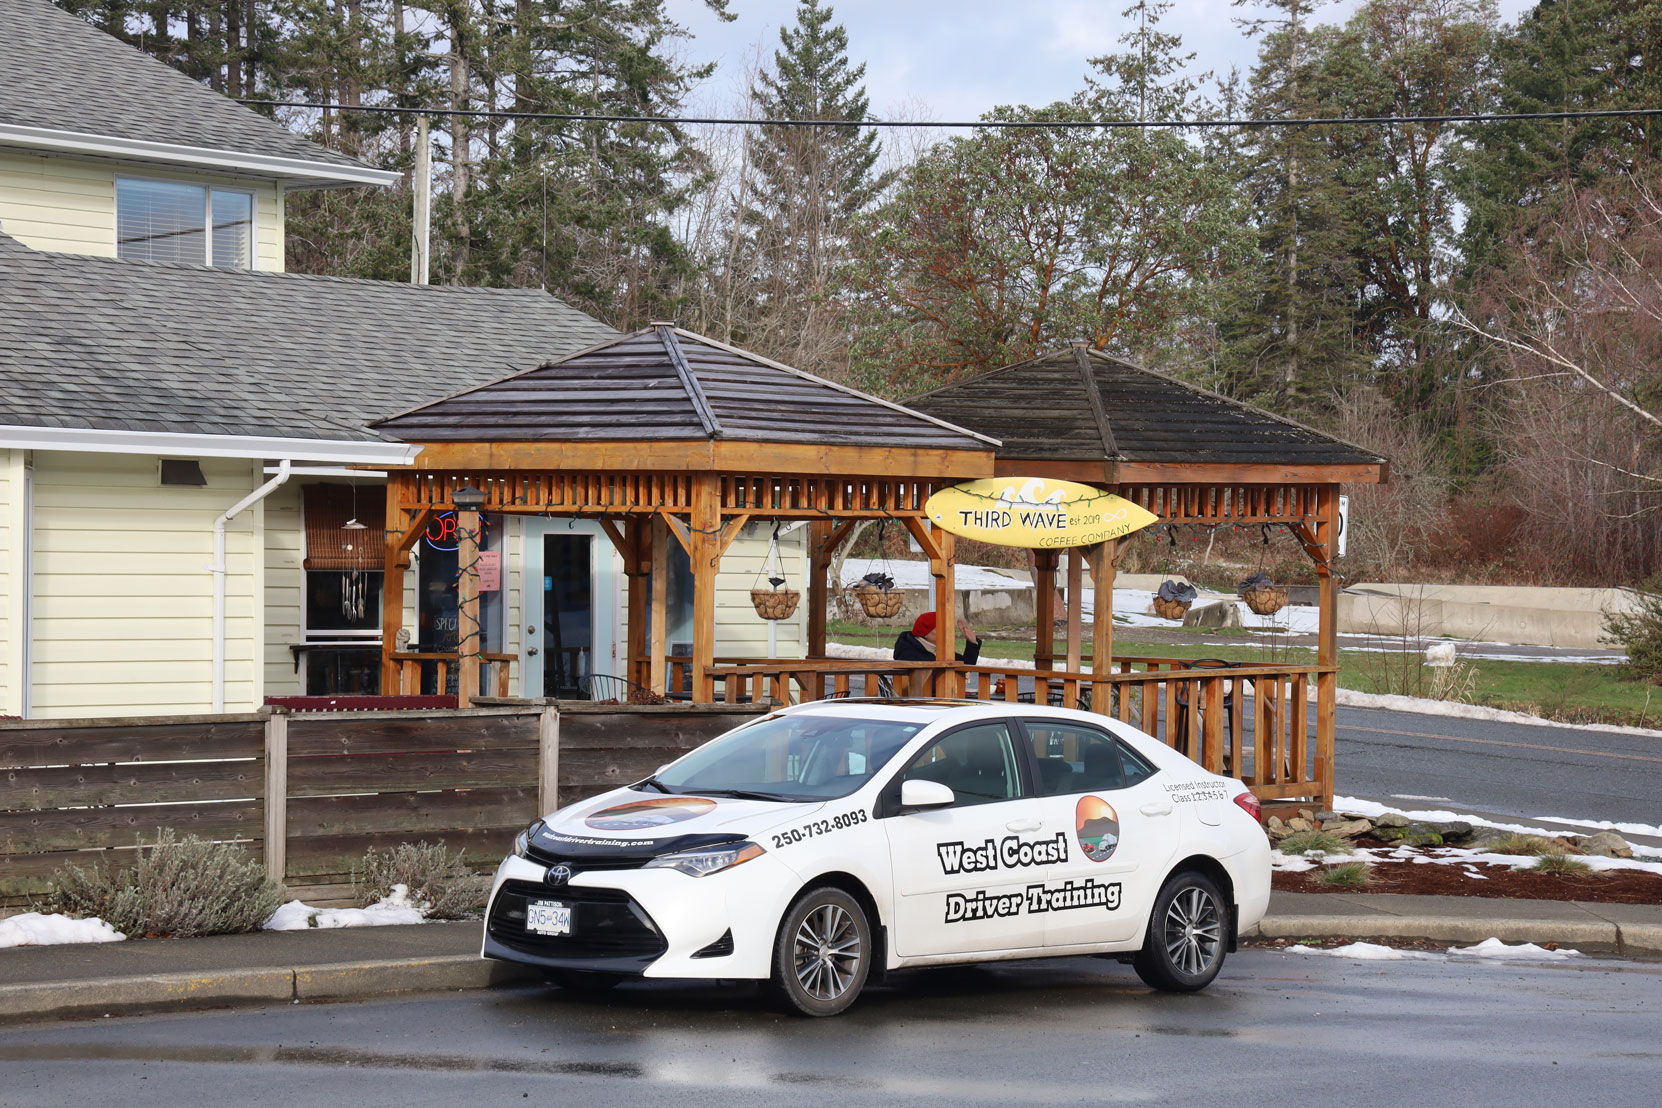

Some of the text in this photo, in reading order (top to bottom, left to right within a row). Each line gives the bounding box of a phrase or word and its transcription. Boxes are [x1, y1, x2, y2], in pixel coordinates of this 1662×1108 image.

[959, 511, 1012, 529] THIRD
[1019, 511, 1067, 529] WAVE
[1083, 513, 1100, 525] 2019
[1038, 523, 1131, 547] COFFEE COMPANY
[1162, 780, 1226, 792] Licensed Instructor
[1171, 792, 1192, 803] Class
[936, 832, 1068, 875] West Coast
[944, 878, 1122, 924] Driver Training
